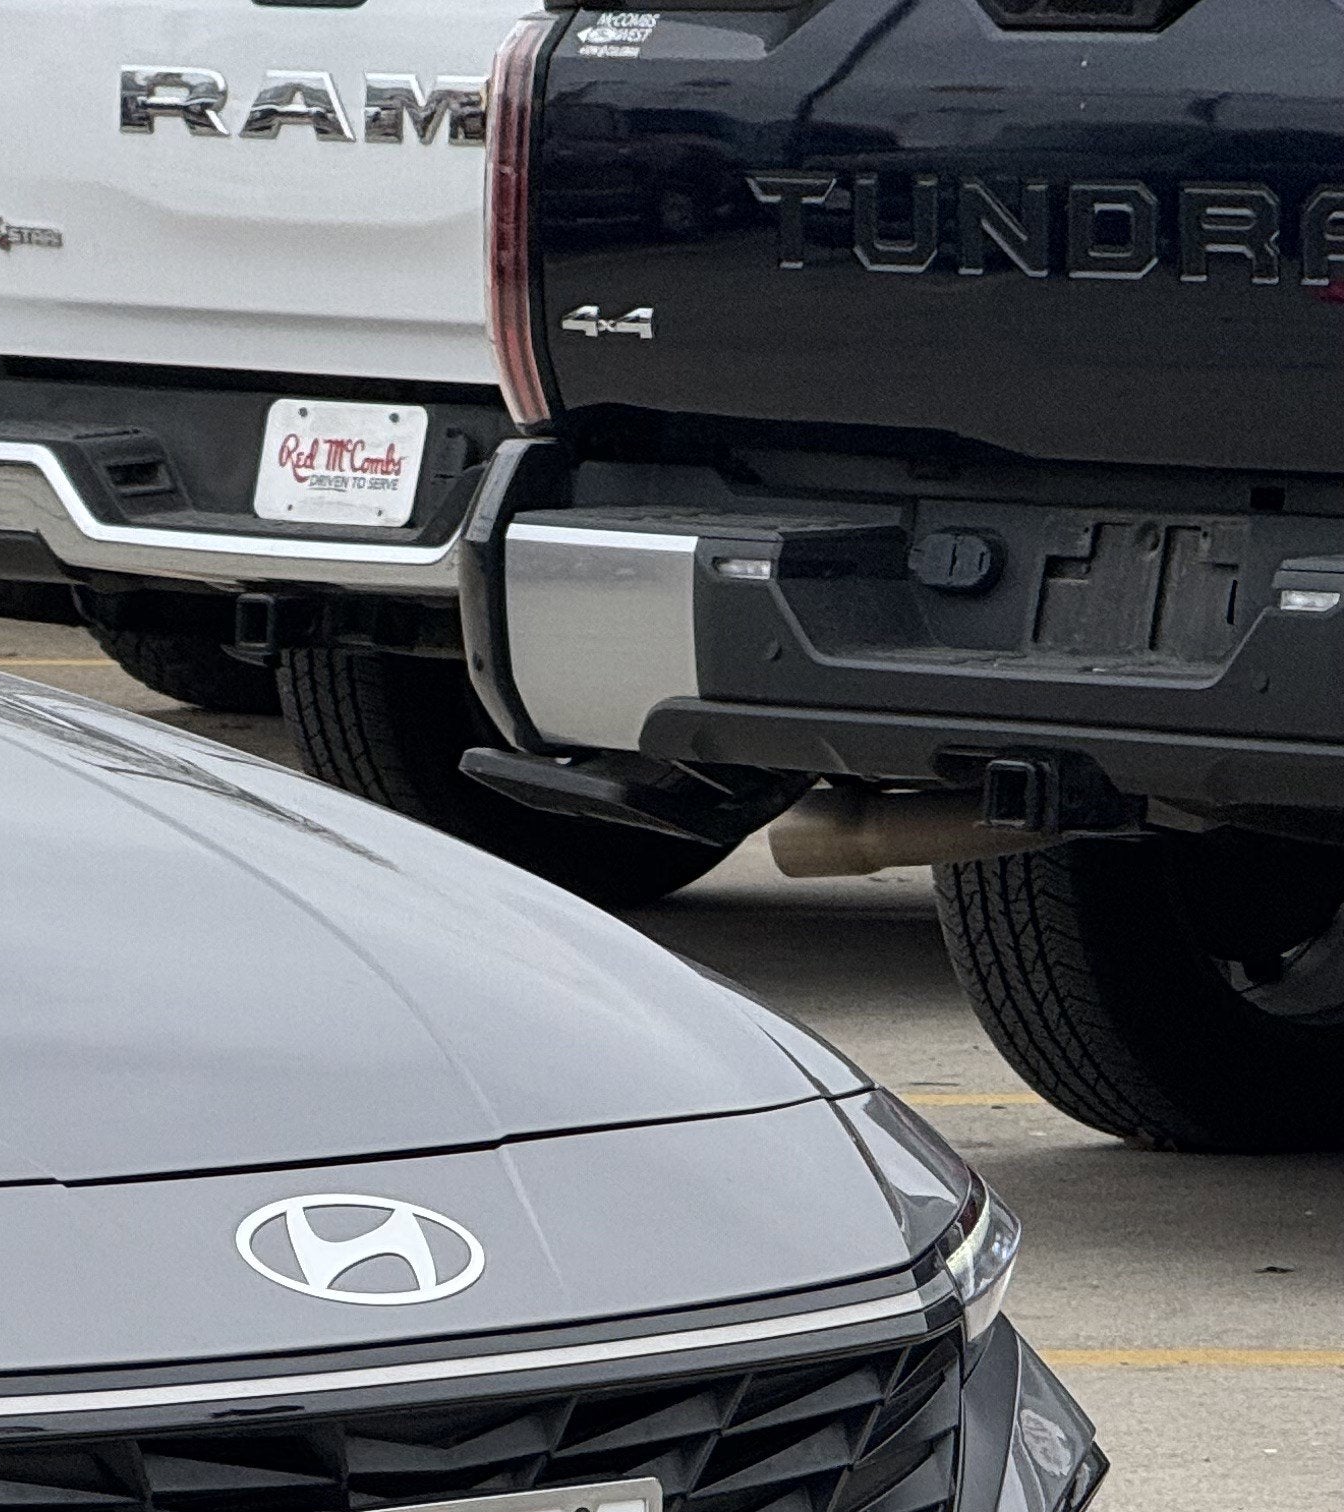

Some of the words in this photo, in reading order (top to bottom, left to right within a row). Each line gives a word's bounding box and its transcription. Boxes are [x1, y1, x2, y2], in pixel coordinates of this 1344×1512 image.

[120, 65, 489, 145] RAM
[279, 434, 319, 483] Red
[324, 439, 402, 476] McCombs
[310, 475, 349, 490] DRIVEN
[351, 476, 366, 490] TO
[368, 478, 399, 490] SERVE
